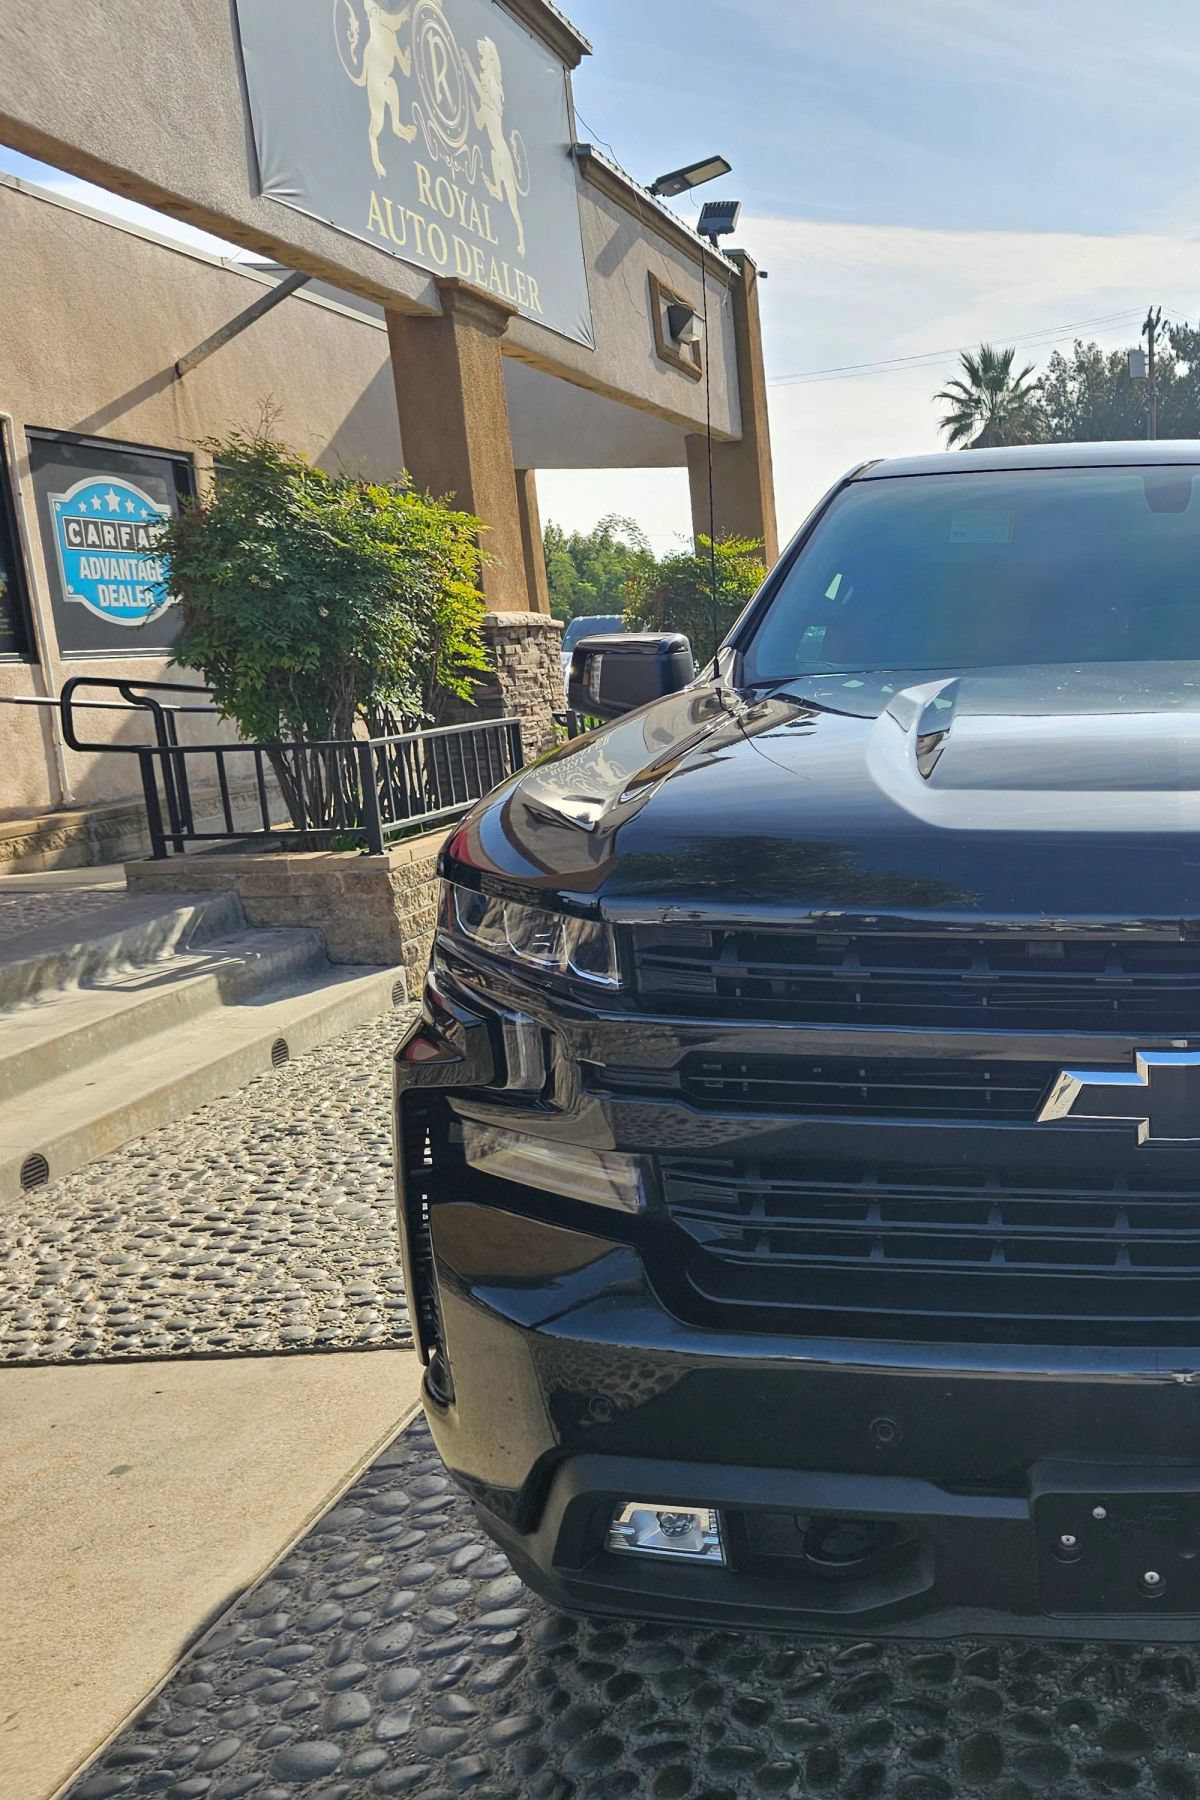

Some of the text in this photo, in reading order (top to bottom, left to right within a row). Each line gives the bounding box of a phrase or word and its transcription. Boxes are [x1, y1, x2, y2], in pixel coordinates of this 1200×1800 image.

[426, 29, 457, 115] R
[413, 160, 499, 246] ROYAL
[365, 189, 544, 314] AUTO DEALER
[97, 584, 156, 607] DEALER
